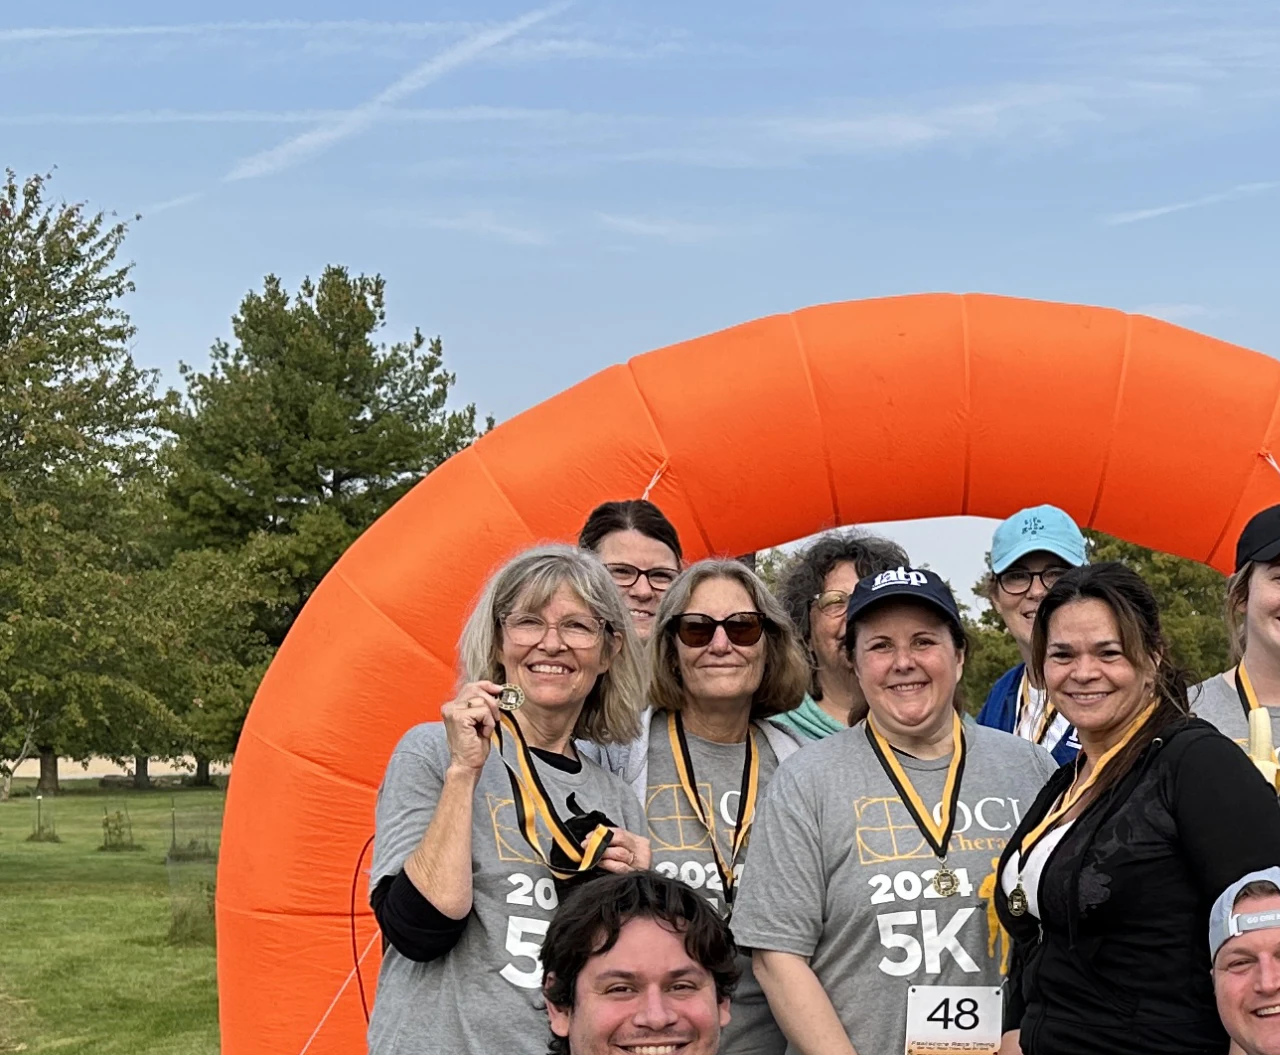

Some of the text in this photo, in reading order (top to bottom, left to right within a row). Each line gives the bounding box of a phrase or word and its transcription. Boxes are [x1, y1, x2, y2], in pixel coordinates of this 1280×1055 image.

[932, 797, 1022, 834] OCI
[506, 873, 559, 910] 20
[868, 868, 973, 905] 2024
[499, 915, 551, 989] 5
[877, 907, 981, 976] 5K
[926, 998, 979, 1030] 48
